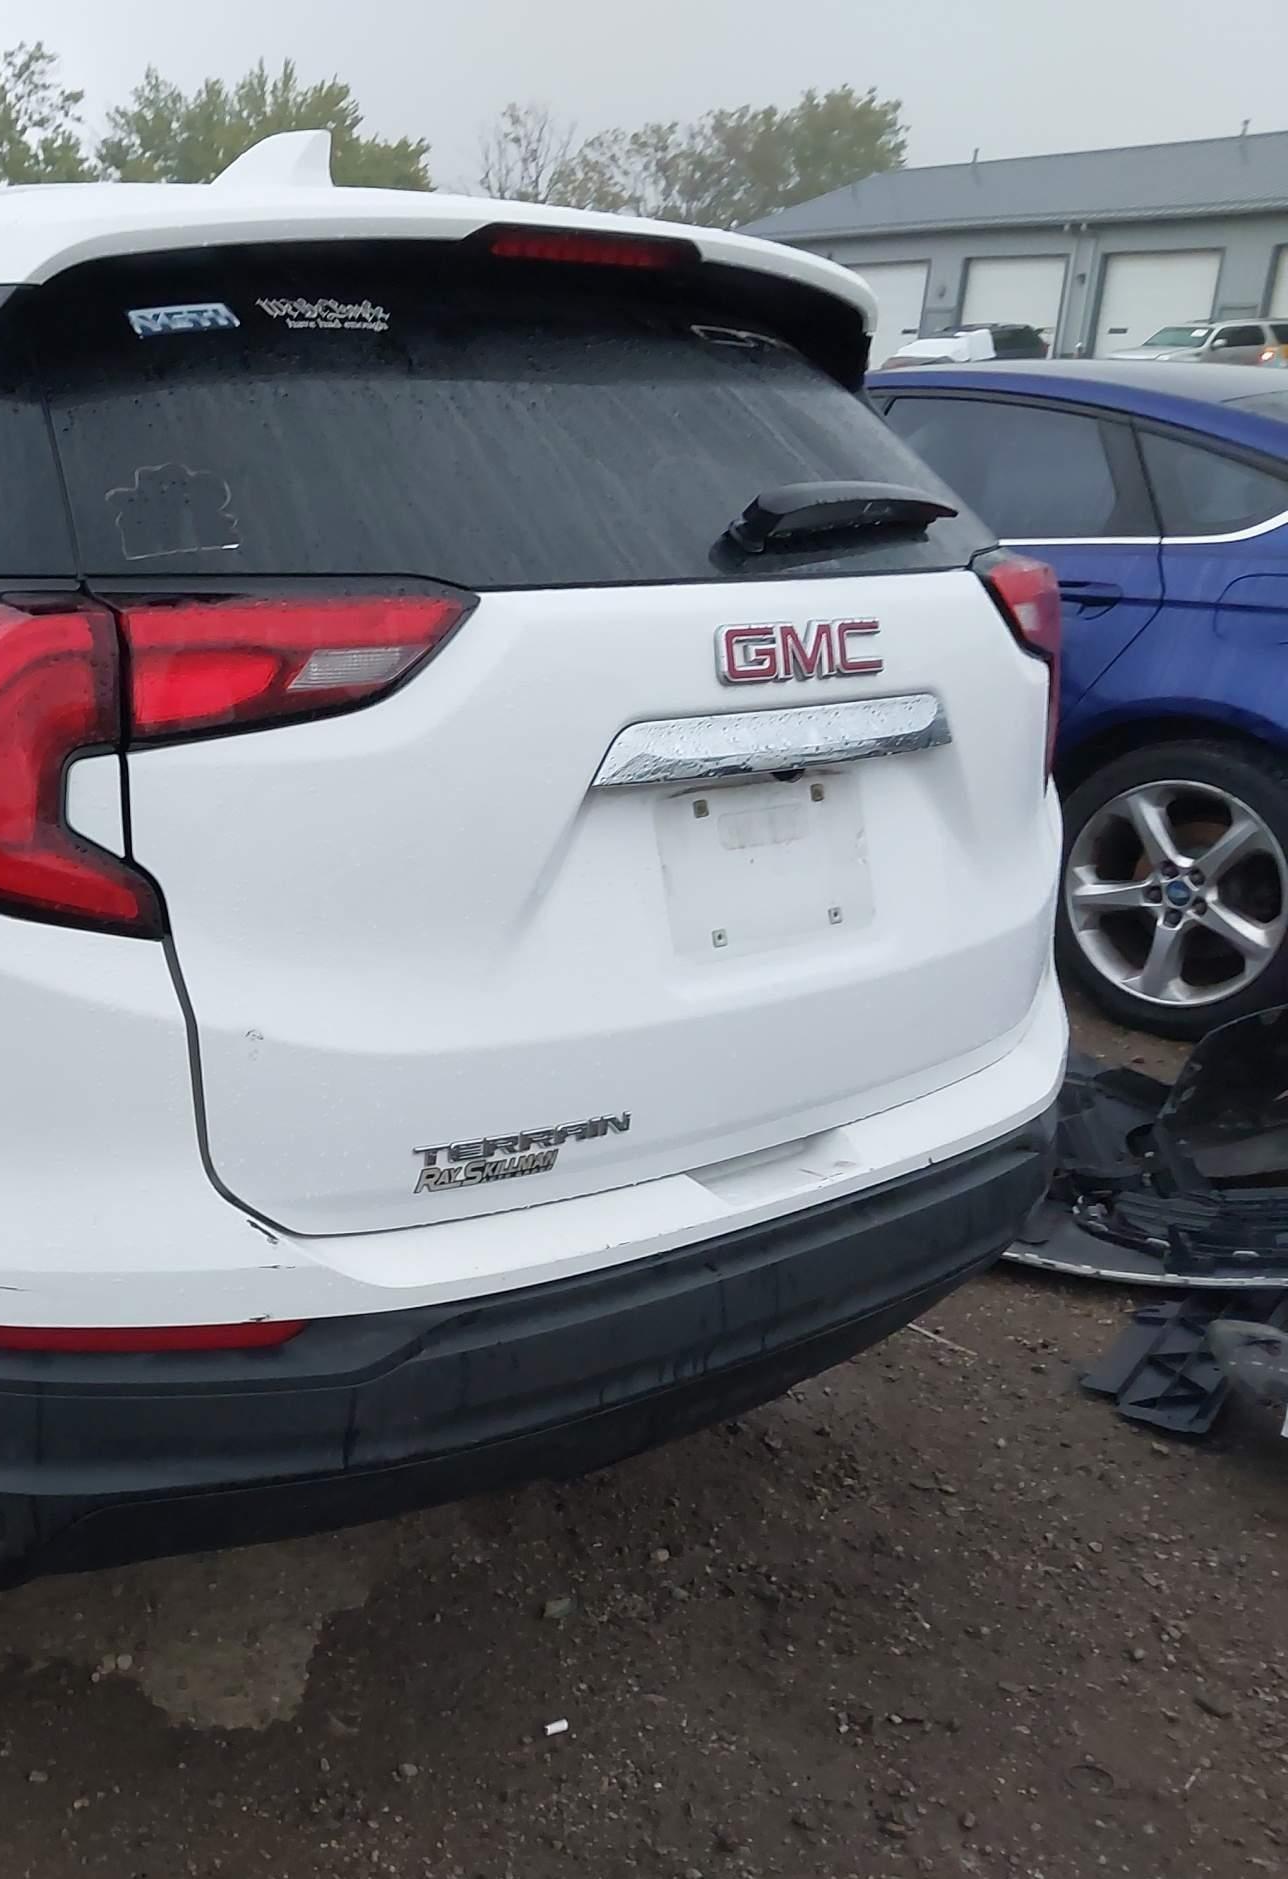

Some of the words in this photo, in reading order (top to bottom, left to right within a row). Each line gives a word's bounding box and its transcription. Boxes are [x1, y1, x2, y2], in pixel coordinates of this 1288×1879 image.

[134, 309, 230, 332] YETI
[715, 618, 884, 686] GMC
[412, 1111, 632, 1167] TERRAIN
